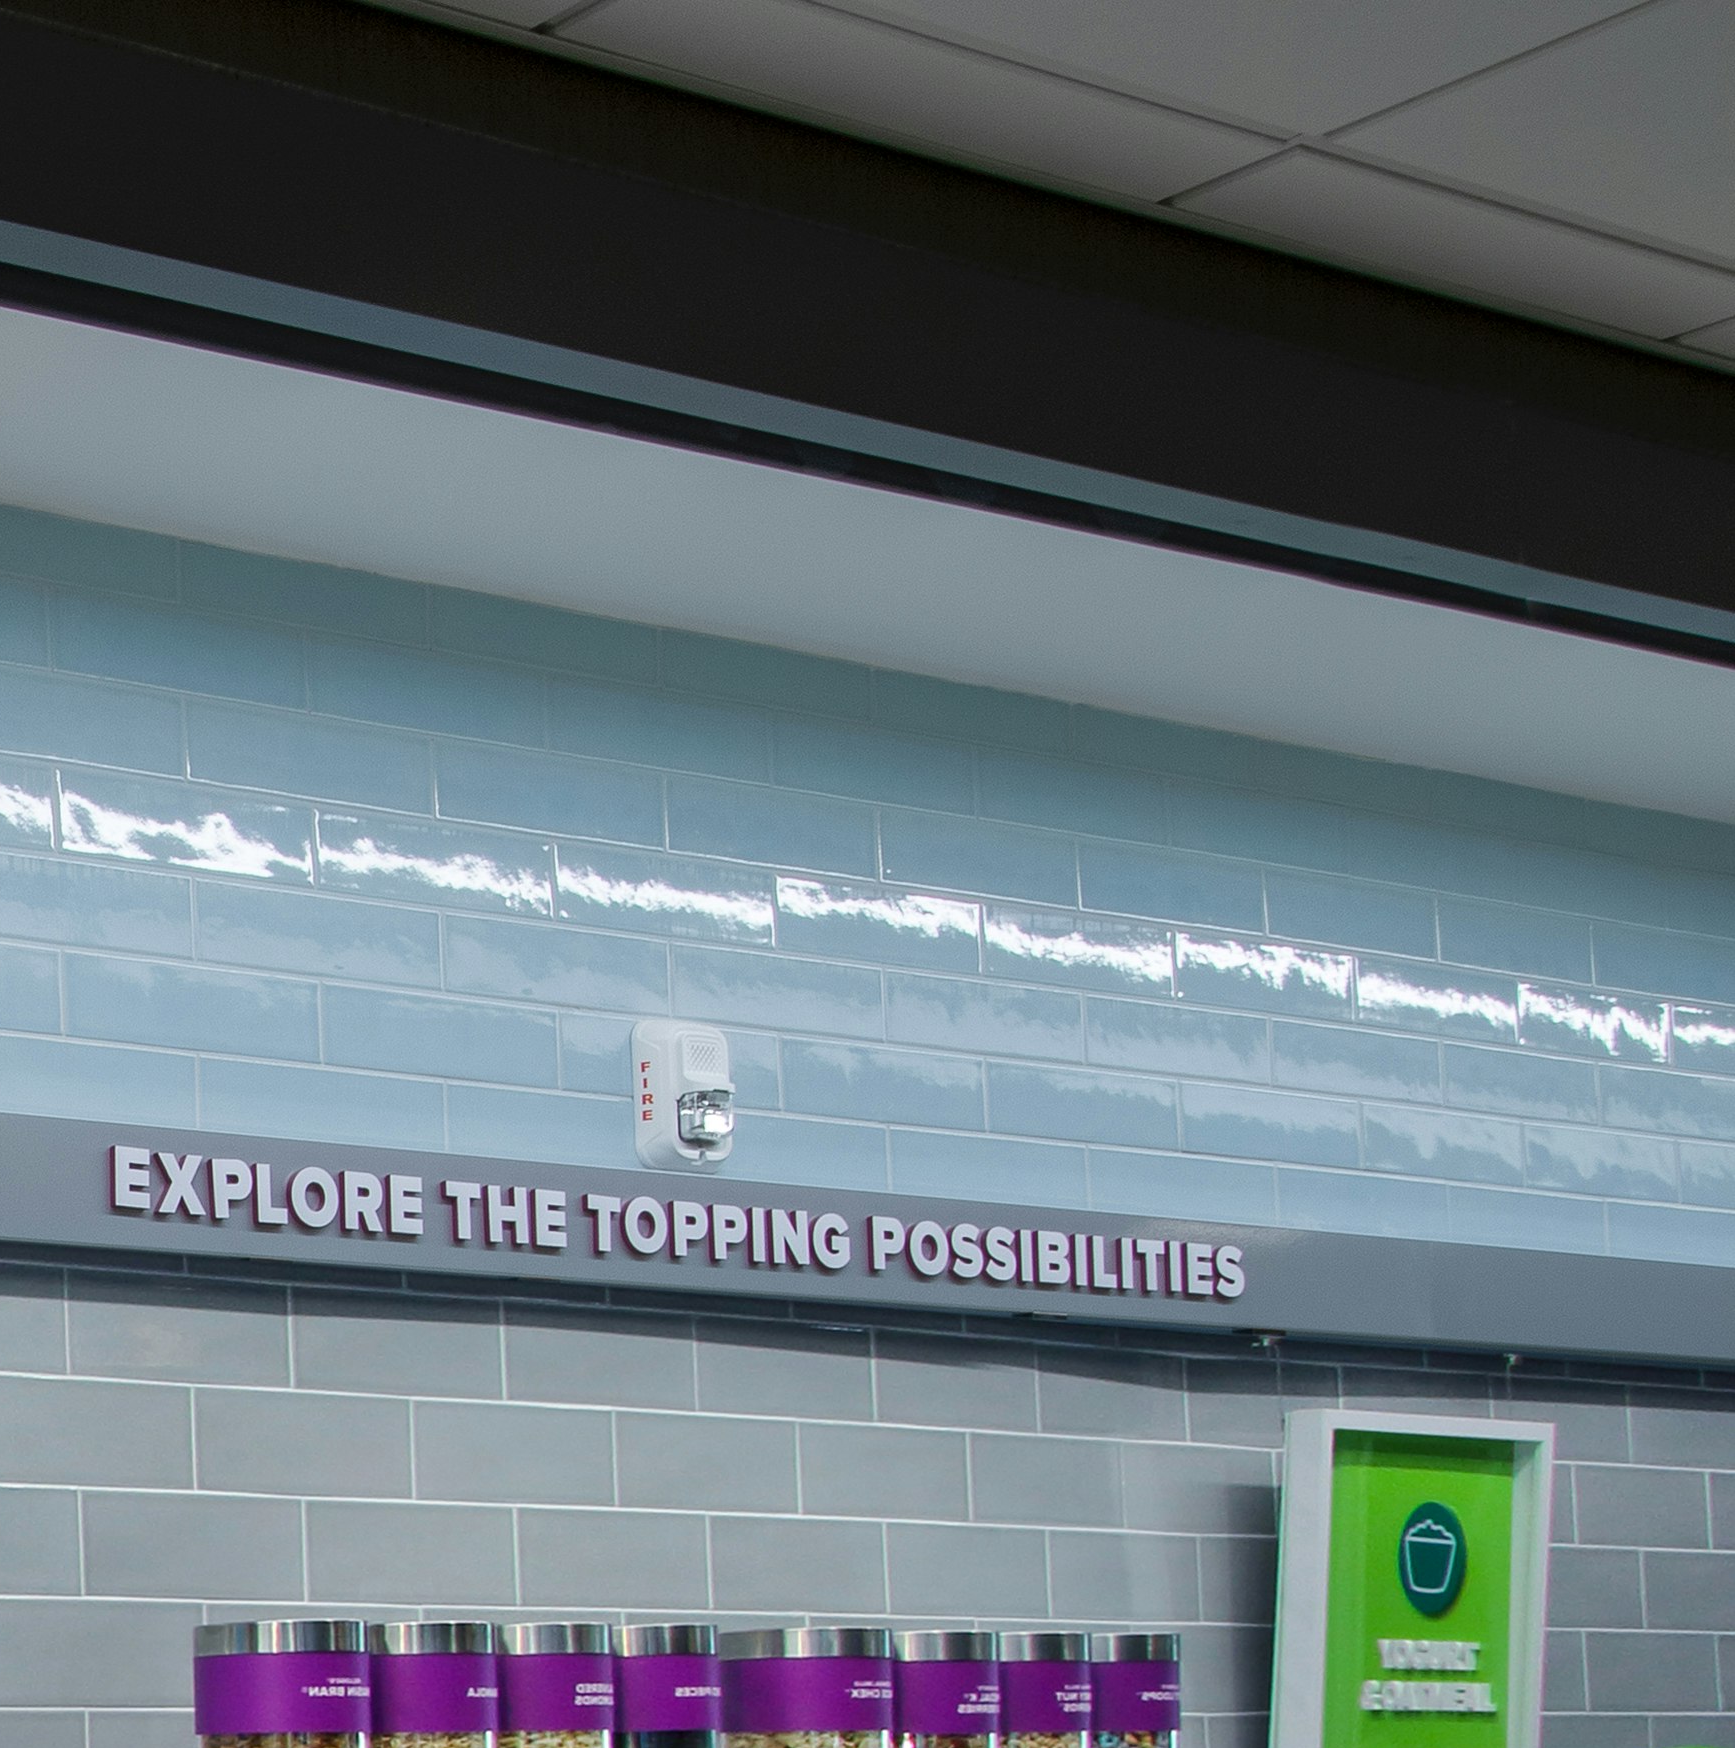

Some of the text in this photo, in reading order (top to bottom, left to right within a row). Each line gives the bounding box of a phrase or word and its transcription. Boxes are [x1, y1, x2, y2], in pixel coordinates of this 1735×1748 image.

[640, 1061, 654, 1121] FIRE
[110, 1145, 1247, 1300] EXPLORE THE TOPPING POSSIBILITIES
